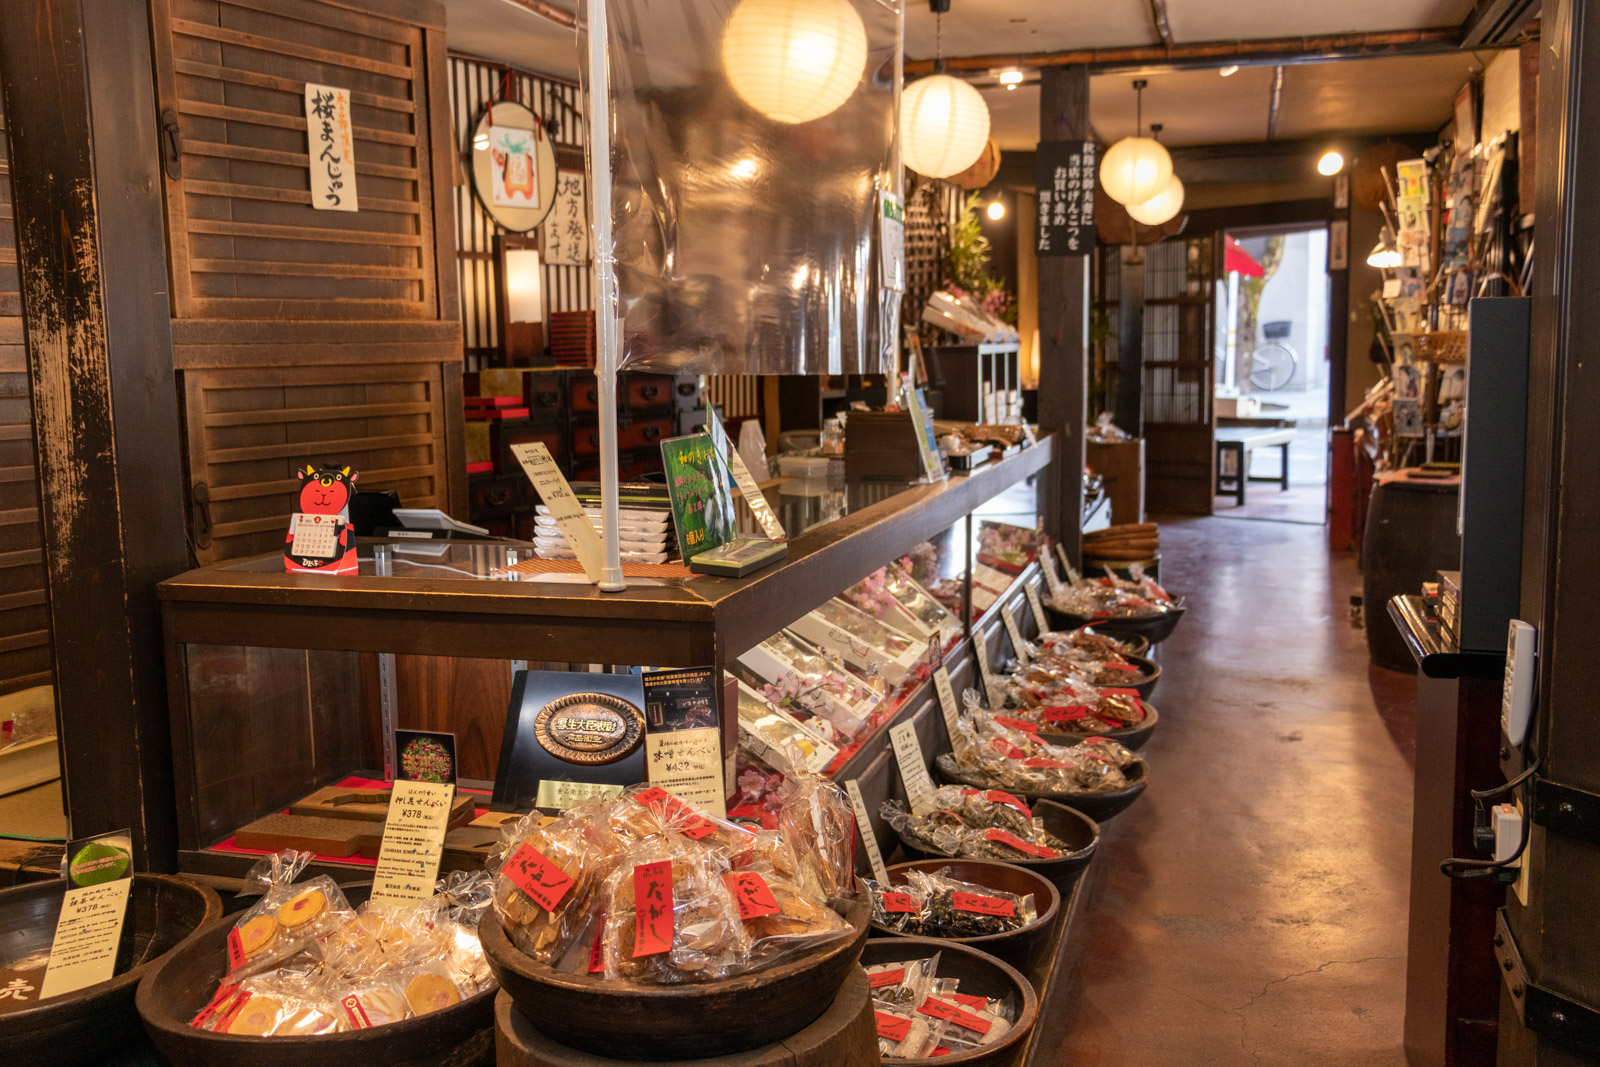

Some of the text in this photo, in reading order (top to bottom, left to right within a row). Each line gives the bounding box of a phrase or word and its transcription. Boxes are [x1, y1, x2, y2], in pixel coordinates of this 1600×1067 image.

[311, 89, 344, 206] 桜まんじゅう
[1053, 166, 1067, 226] お買い求め
[1067, 153, 1081, 251] 当店のげんこつを
[550, 183, 563, 260] ります
[563, 175, 584, 264] 地方発送
[1039, 190, 1052, 251] 頂きました
[556, 717, 617, 732] 厚生大臣表彰
[565, 732, 603, 744] 食品衛生
[653, 746, 716, 761] 味噌せんべい
[666, 761, 690, 772] ¥432
[394, 795, 447, 808] 押し花せんべい
[402, 809, 422, 819] ¥378
[520, 855, 569, 889] だがし
[69, 890, 123, 907] 抹茶せんべい
[738, 877, 775, 909] だがし
[965, 896, 1007, 909] だがし
[76, 903, 98, 914] ¥378
[646, 880, 670, 945] だがし
[934, 1004, 988, 1023] だがし
